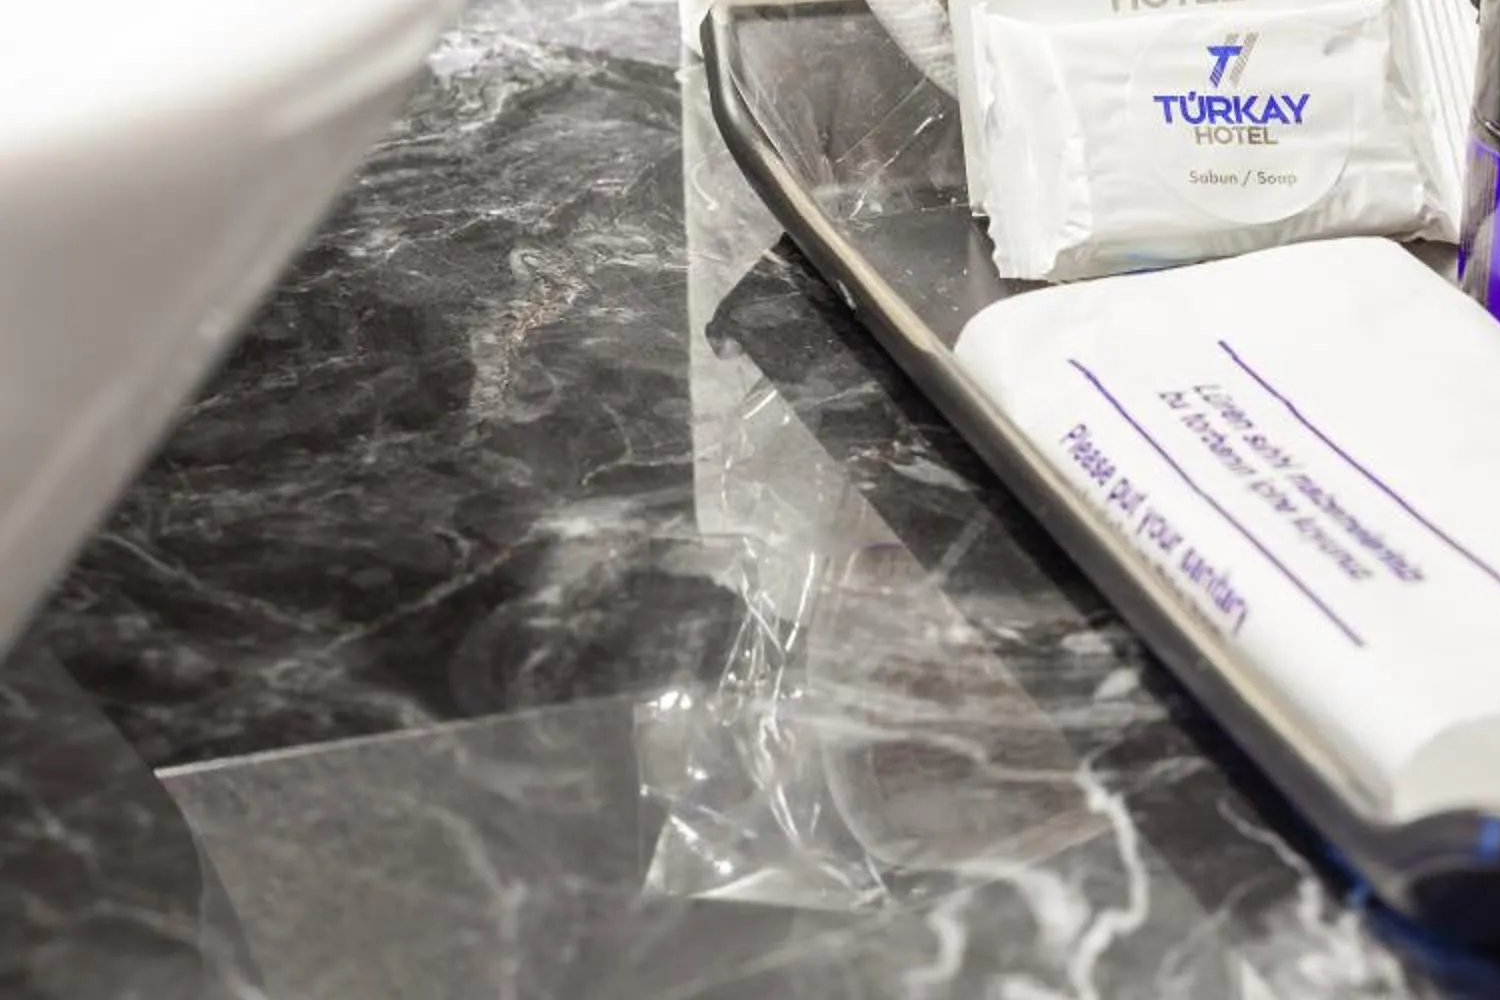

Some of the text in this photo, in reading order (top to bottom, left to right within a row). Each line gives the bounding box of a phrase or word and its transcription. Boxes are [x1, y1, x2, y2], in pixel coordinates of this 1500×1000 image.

[1193, 125, 1280, 146] HOTEL
[1188, 170, 1240, 186] Sabun
[1256, 170, 1298, 187] Soap
[1059, 423, 1117, 488] Please
[1105, 477, 1148, 517] put
